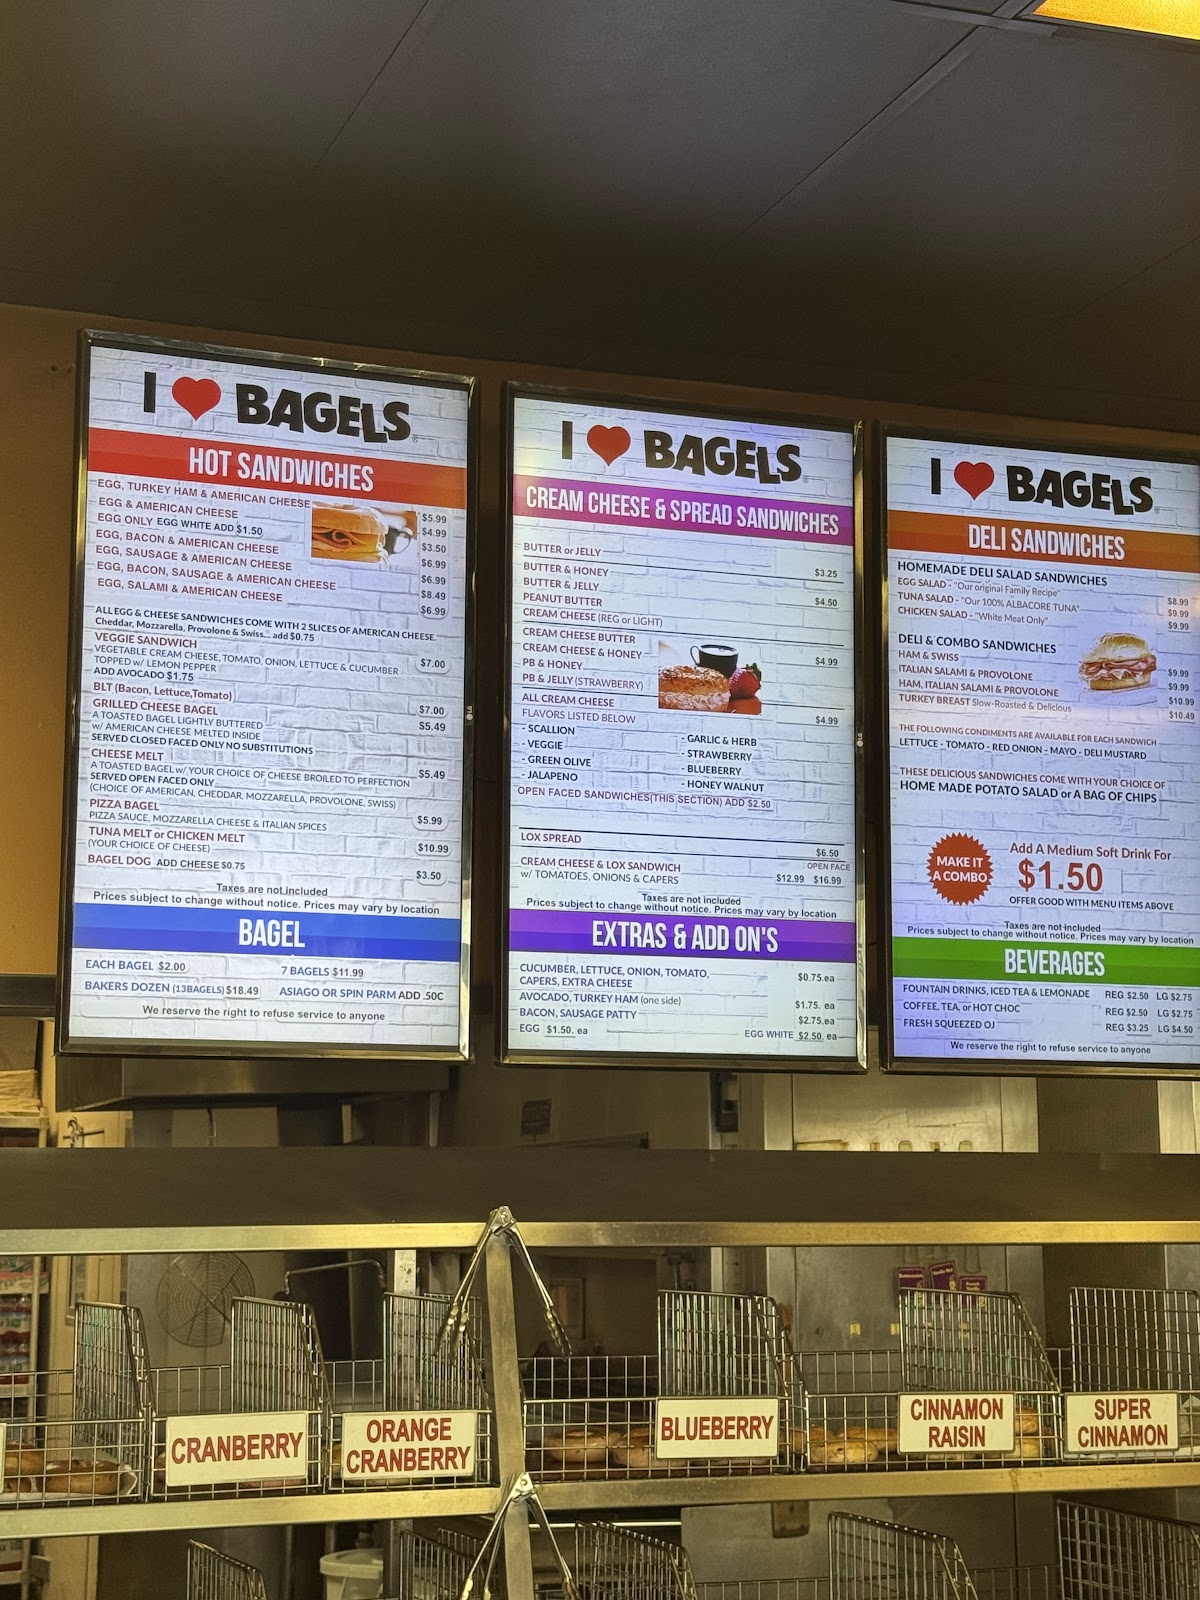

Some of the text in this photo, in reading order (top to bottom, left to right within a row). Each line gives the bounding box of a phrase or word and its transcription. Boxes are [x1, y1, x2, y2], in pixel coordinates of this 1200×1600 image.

[143, 371, 411, 443] I BAGELS
[562, 420, 801, 484] I BAGELS
[189, 447, 374, 493] HOT SANDWICHES
[97, 478, 310, 508] EGG, TURKEY HAM & AMERICAN CHEESE
[931, 458, 1153, 515] I BAGELS
[98, 496, 238, 519] EGG & AMERICAN CHEESE
[526, 485, 839, 535] CREAM CHEESE & SPREAD SANDWICHES
[422, 512, 447, 524] $5.99
[421, 526, 446, 538] $4.99
[421, 542, 446, 554] $3.50
[968, 523, 1125, 560] DELI SANDWICHES
[523, 542, 562, 554] BUTTER
[575, 547, 601, 557] JELLY
[421, 558, 446, 569] $6.99
[523, 562, 609, 577] BUTTER & HONEY
[814, 568, 837, 579] $3.25
[897, 561, 1107, 586] HOMEMADE DELI SALAD SANDWICHES
[814, 597, 837, 607] $4.50
[1167, 597, 1188, 607] $8.99
[1167, 608, 1189, 618] $9.99
[1167, 621, 1189, 631] $9.99
[94, 632, 197, 649] VEGGIE SANDWICH
[522, 627, 635, 643] CREAM CHEESE BUTTER
[898, 633, 1056, 653] DELI & COMBO SANDWICHES
[814, 656, 838, 667] $4.99
[898, 650, 958, 661] HAM & SWISS
[93, 655, 216, 672] TOPPED w/ LEMON PEPPER
[420, 658, 445, 669] $7.00
[1167, 668, 1189, 678] $9.99
[521, 692, 614, 707] ALL CREAM CHEESE
[92, 698, 218, 715] GRILLED CHEESE BAGEL
[522, 708, 636, 724] FLAVORS LISTED BELOW
[815, 715, 838, 725] $4.99
[1168, 710, 1195, 721] $10.49
[418, 721, 446, 732] $5.49
[528, 724, 574, 735] SCALLION
[527, 739, 563, 749] VEGGIE
[527, 755, 591, 766] GREEN OLIVE
[687, 749, 752, 761] STRAWBERRY
[687, 764, 741, 775] BLUEBERRY
[900, 780, 1157, 803] HOME MADE POTATO SALAD or A BAG OF CHIPS
[89, 799, 161, 811] PIZZA BAGEL
[416, 815, 442, 826] $5.99
[88, 827, 121, 837] TUNA
[123, 828, 152, 838] MELT
[166, 830, 214, 841] CHICKEN
[217, 833, 245, 843] MELT
[521, 832, 581, 843] LOX SPREAD
[418, 842, 449, 853] $10.99
[816, 848, 838, 858] $6.50
[1009, 842, 1171, 860] Add A Medium Soft Drink For
[806, 862, 851, 871] OPEN FACE
[936, 855, 983, 868] MAKE IT
[775, 873, 841, 885] $12.99 $16.99
[932, 870, 987, 883] A COMBO
[1018, 857, 1103, 894] $1.50
[1009, 896, 1174, 910] OFFER GOOD WITH MENU ITEMS ABOVE
[238, 918, 305, 949] BAGEL
[592, 920, 779, 952] EXTRAS & ADD ON'S
[85, 960, 186, 972] EACH BAGEL $2.00
[1005, 948, 1105, 976] BEVERAGES
[281, 966, 364, 978] 7 BAGELS $11.99
[904, 1018, 995, 1029] FRESH SQUEEZED OJ
[1105, 1023, 1193, 1034] REG $3.25 LG $4.50
[910, 1398, 1003, 1421] CINNAMON
[1094, 1398, 1151, 1421] SUPER
[366, 1417, 452, 1443] ORANGE
[661, 1414, 774, 1441] BLUEBERRY
[928, 1425, 986, 1448] RAISIN
[1077, 1424, 1168, 1448] CINNAMON
[171, 1432, 303, 1465] CRANBERRY
[346, 1446, 470, 1473] CRANBERRY
